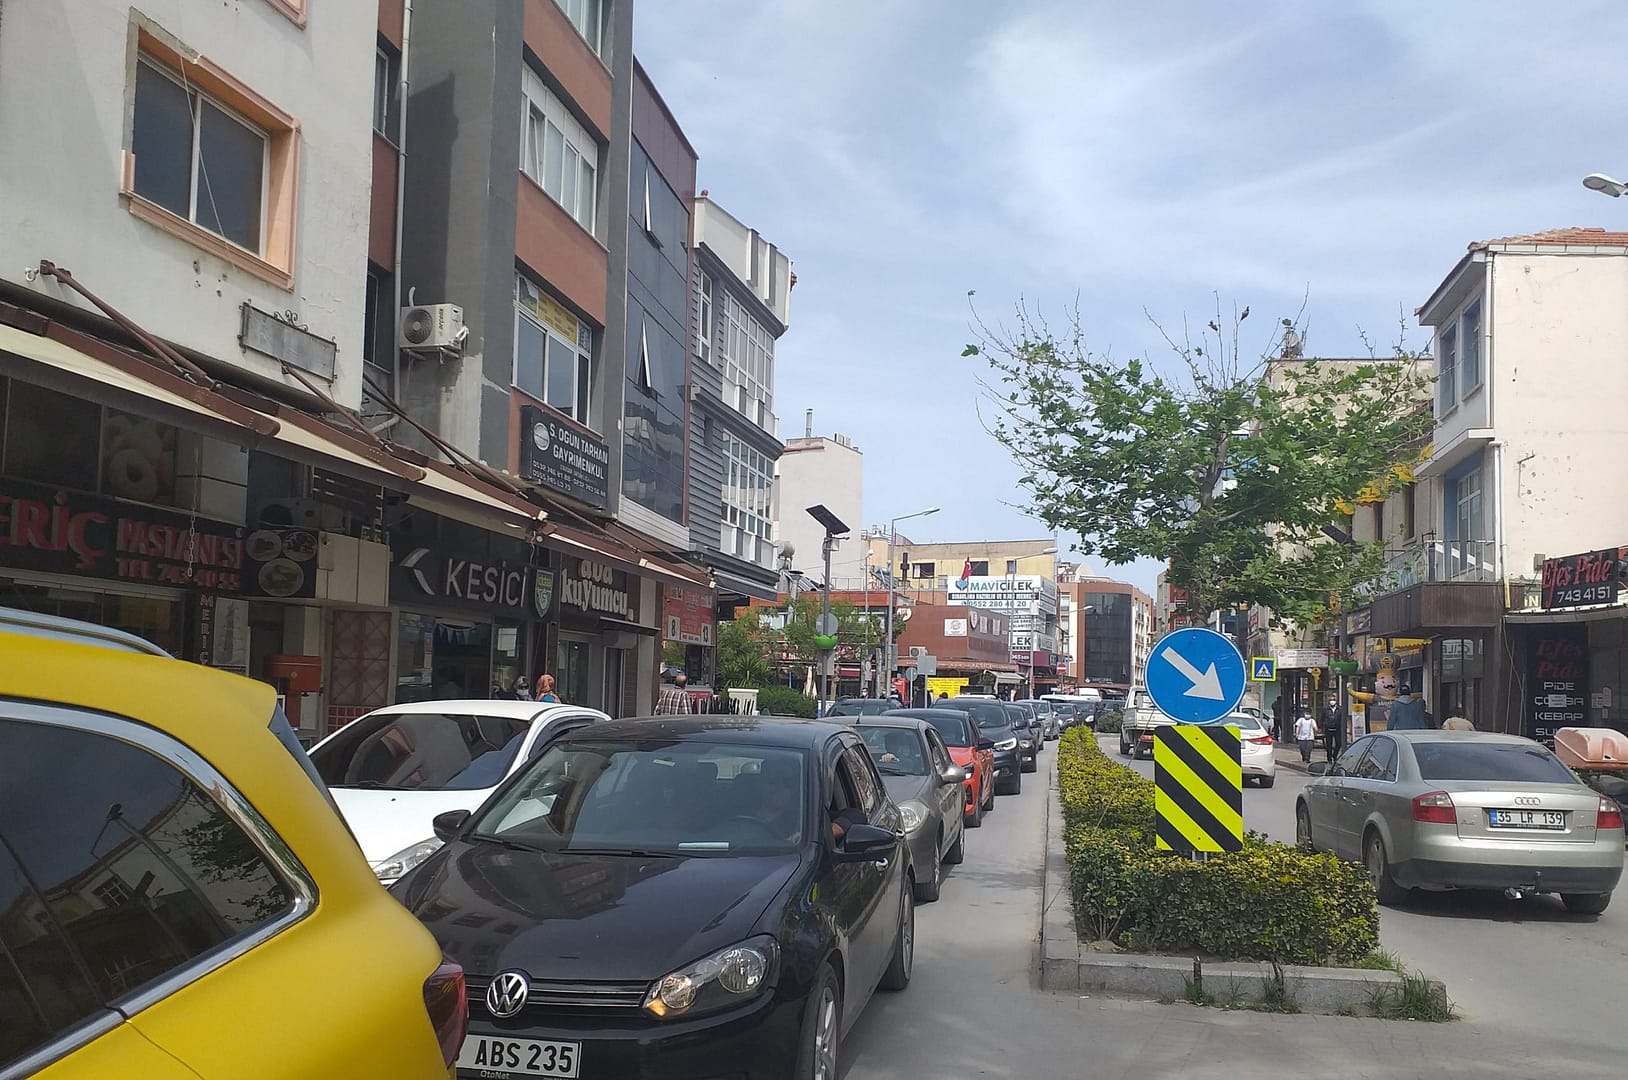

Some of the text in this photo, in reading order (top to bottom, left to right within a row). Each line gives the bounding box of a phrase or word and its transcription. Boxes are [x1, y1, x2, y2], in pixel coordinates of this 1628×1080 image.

[580, 439, 609, 465] TARHAN
[116, 518, 243, 569] PASTANESİ
[446, 557, 528, 608] KESİCİ
[561, 568, 628, 616] kuyumcu
[1542, 552, 1613, 608] Efes Pide
[1557, 586, 1611, 603] 743 41 51
[1535, 712, 1584, 722] KEBAP
[1497, 811, 1563, 825] 35 LR 139
[474, 1039, 574, 1074] ABS 235
